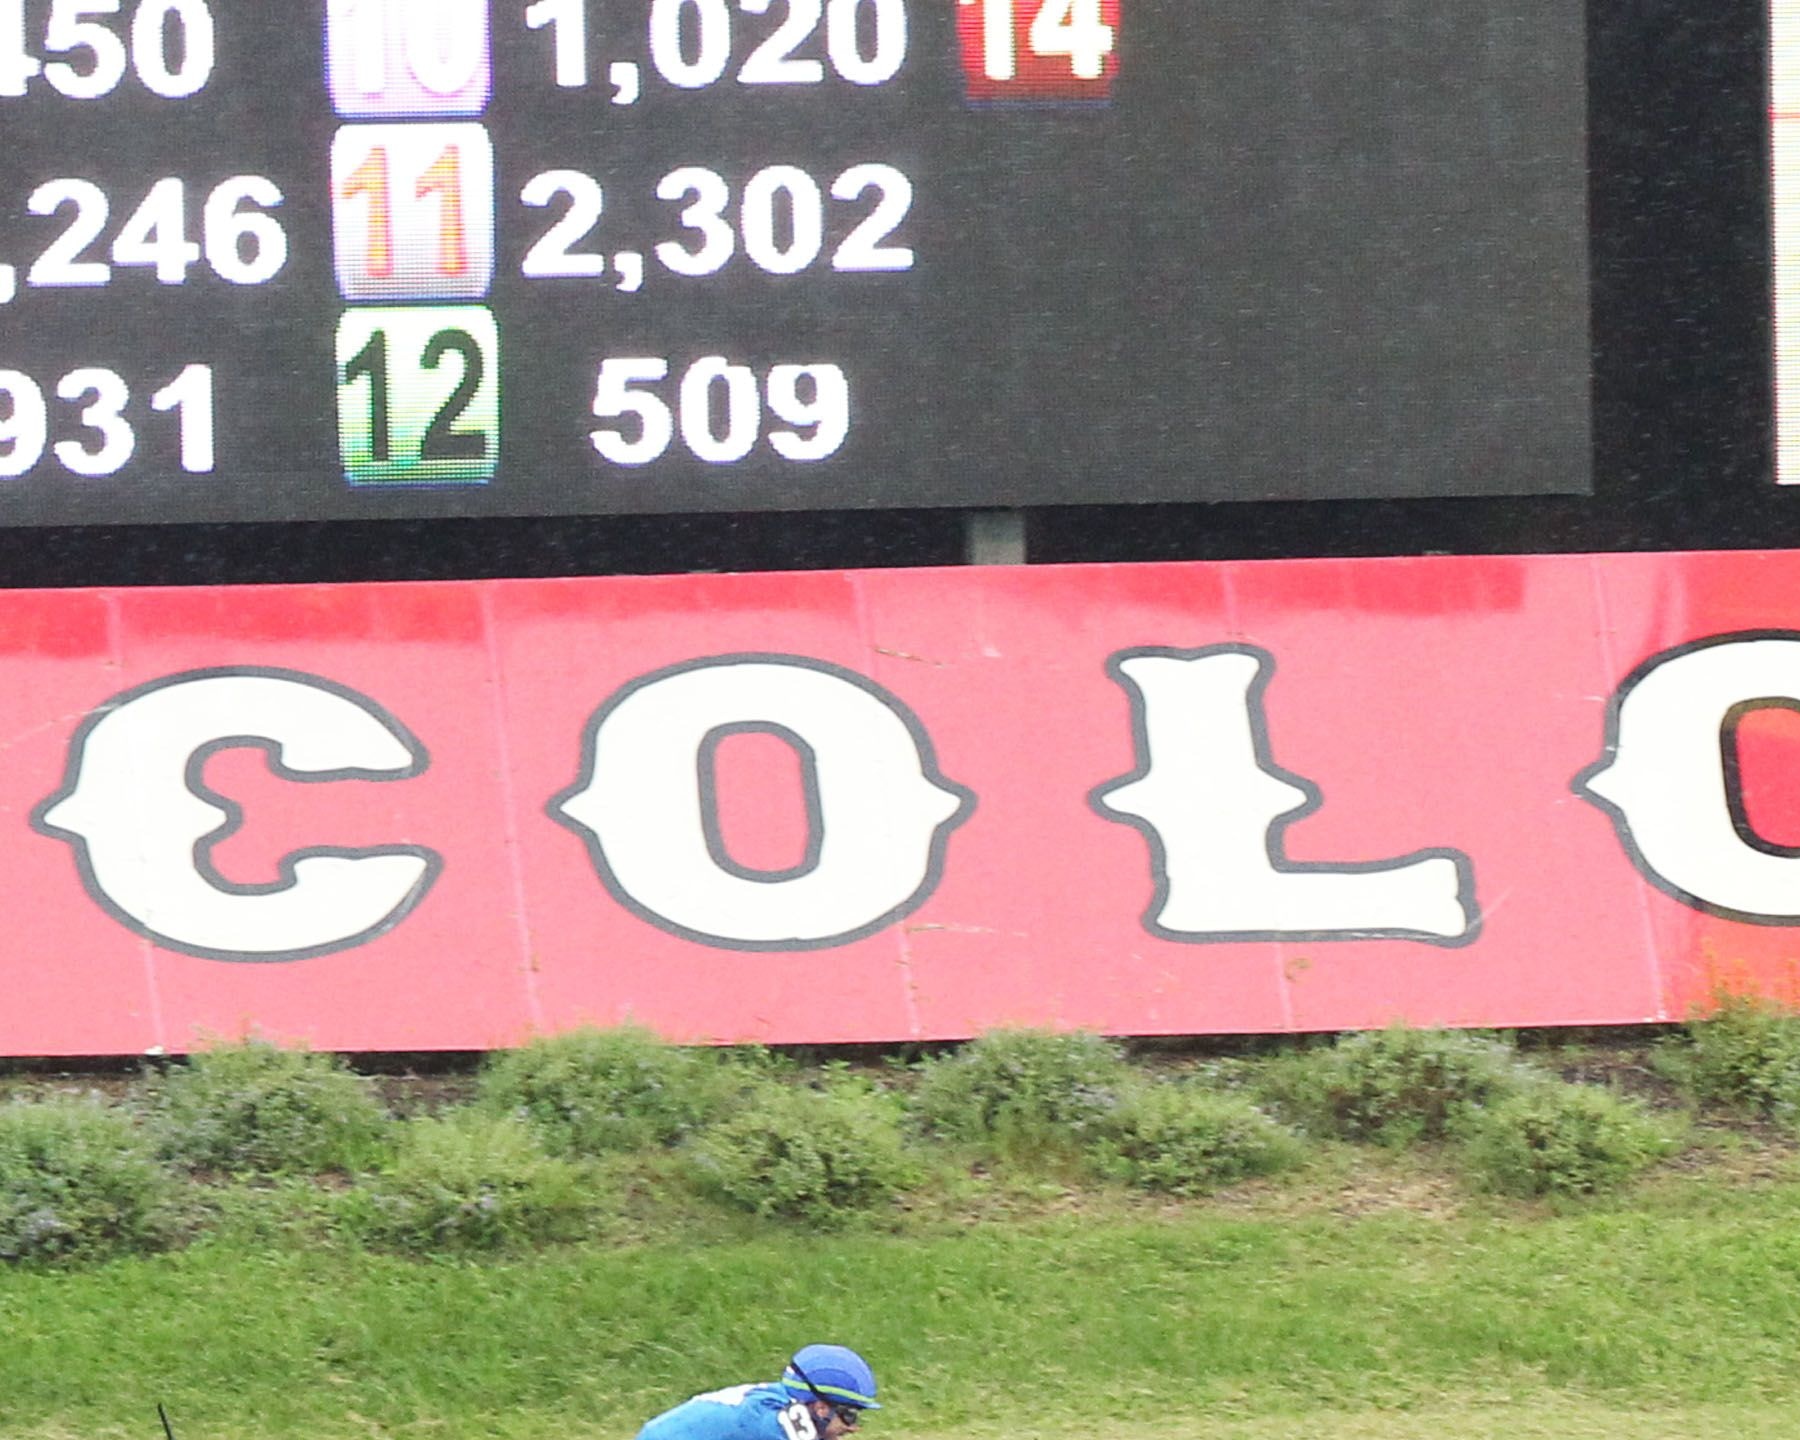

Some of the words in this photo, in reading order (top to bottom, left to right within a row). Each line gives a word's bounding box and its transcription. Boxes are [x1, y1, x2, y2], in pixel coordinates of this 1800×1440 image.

[338, 0, 484, 94] 10
[526, 0, 906, 104] 1,020
[957, 0, 1113, 80] 14
[341, 144, 469, 279] 11
[520, 163, 915, 292] 2,302
[344, 328, 486, 463] 12
[591, 356, 850, 465] 509
